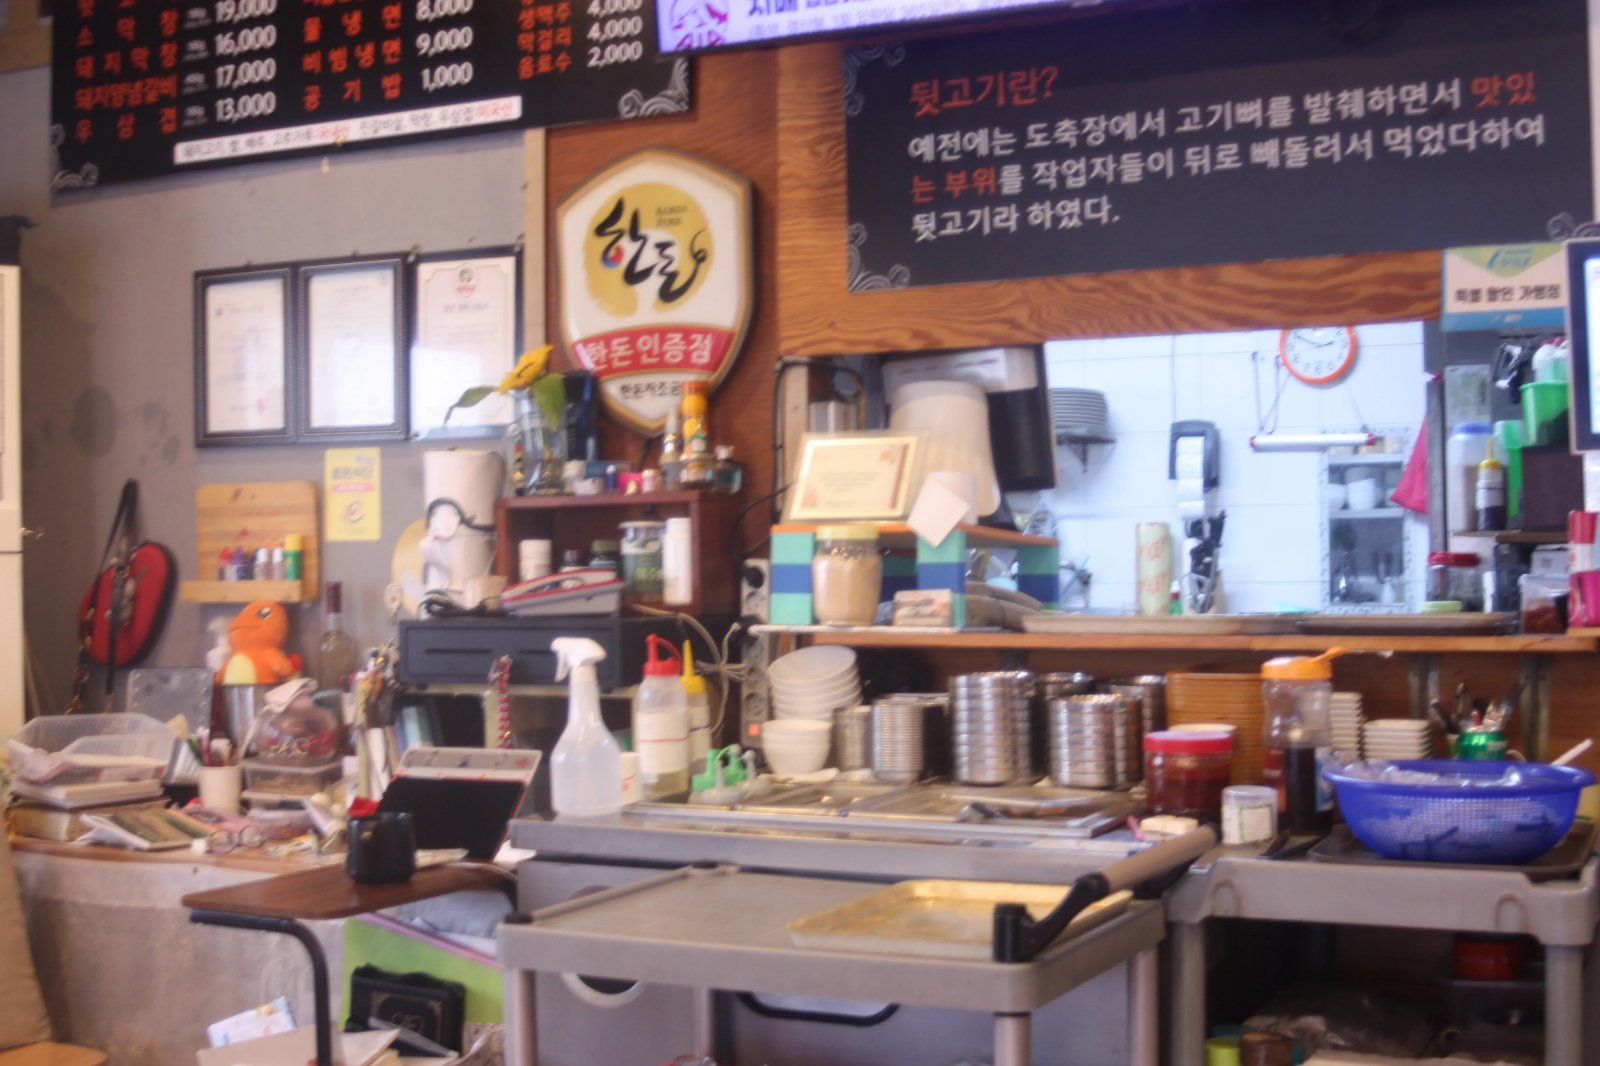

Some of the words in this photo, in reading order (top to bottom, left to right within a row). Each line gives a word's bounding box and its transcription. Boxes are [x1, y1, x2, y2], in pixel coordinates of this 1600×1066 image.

[214, 0, 278, 24] 19,000
[415, 0, 474, 22] 8,000
[586, 0, 643, 18] 4,000
[214, 24, 277, 57] 16,000
[415, 26, 475, 58] 9,000
[516, 25, 573, 53] 막걸리
[586, 15, 643, 43] 4,000
[302, 38, 402, 75] 비빔냉면
[518, 50, 573, 80] 음료수
[586, 40, 643, 69] 2,000
[214, 57, 277, 91] 17,000
[421, 61, 475, 93] 1,000
[74, 73, 178, 112] 돼지양념갈비
[214, 91, 277, 124] 13,000
[910, 65, 1060, 119] 뒷고기란?
[907, 126, 1018, 164] 예전에는
[1024, 107, 1167, 150] 도축장에서
[1174, 94, 1295, 134] 고기뼈를
[1469, 70, 1537, 110] 맛있
[911, 174, 936, 205] 는
[944, 163, 1025, 199] 부위를
[1032, 147, 1175, 191] 작업자들이
[1183, 142, 1245, 177] 뒤로
[1249, 129, 1374, 170] 빼돌려서
[1383, 112, 1545, 158] 먹었다하여
[910, 202, 1020, 243] 뒷고기라
[1026, 194, 1121, 232] 하였다.
